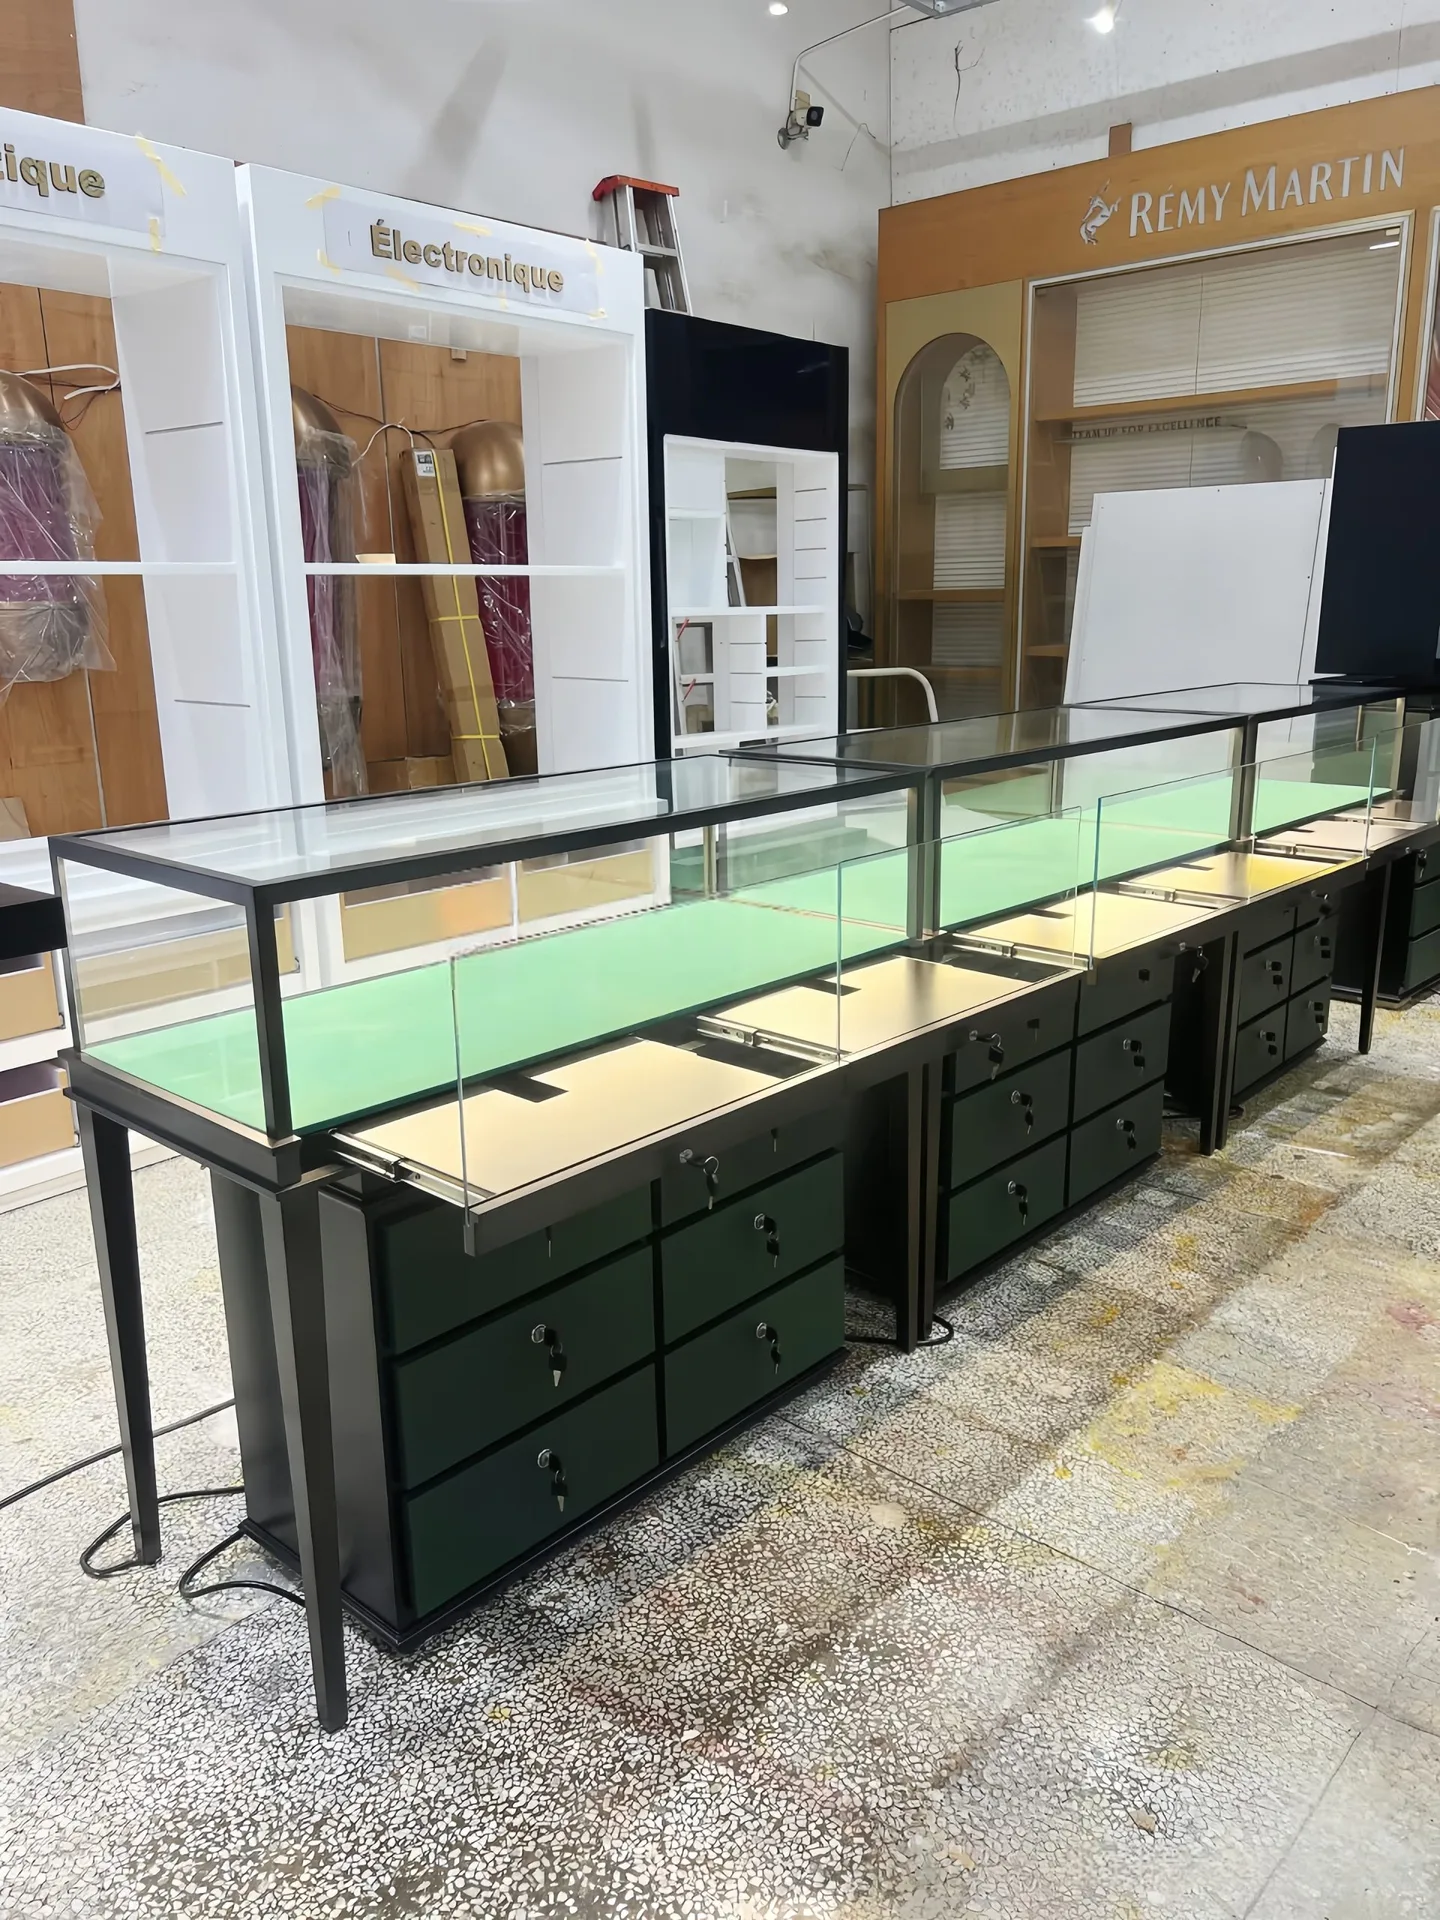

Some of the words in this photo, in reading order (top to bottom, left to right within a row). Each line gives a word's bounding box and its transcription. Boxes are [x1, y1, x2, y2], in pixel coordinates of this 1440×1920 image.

[0, 143, 105, 198] ique
[1129, 182, 1231, 238] RÉMY
[1241, 147, 1405, 217] MARTIN
[370, 218, 565, 294] Électronique
[1072, 429, 1101, 439] TEAM
[1104, 427, 1118, 438] UP
